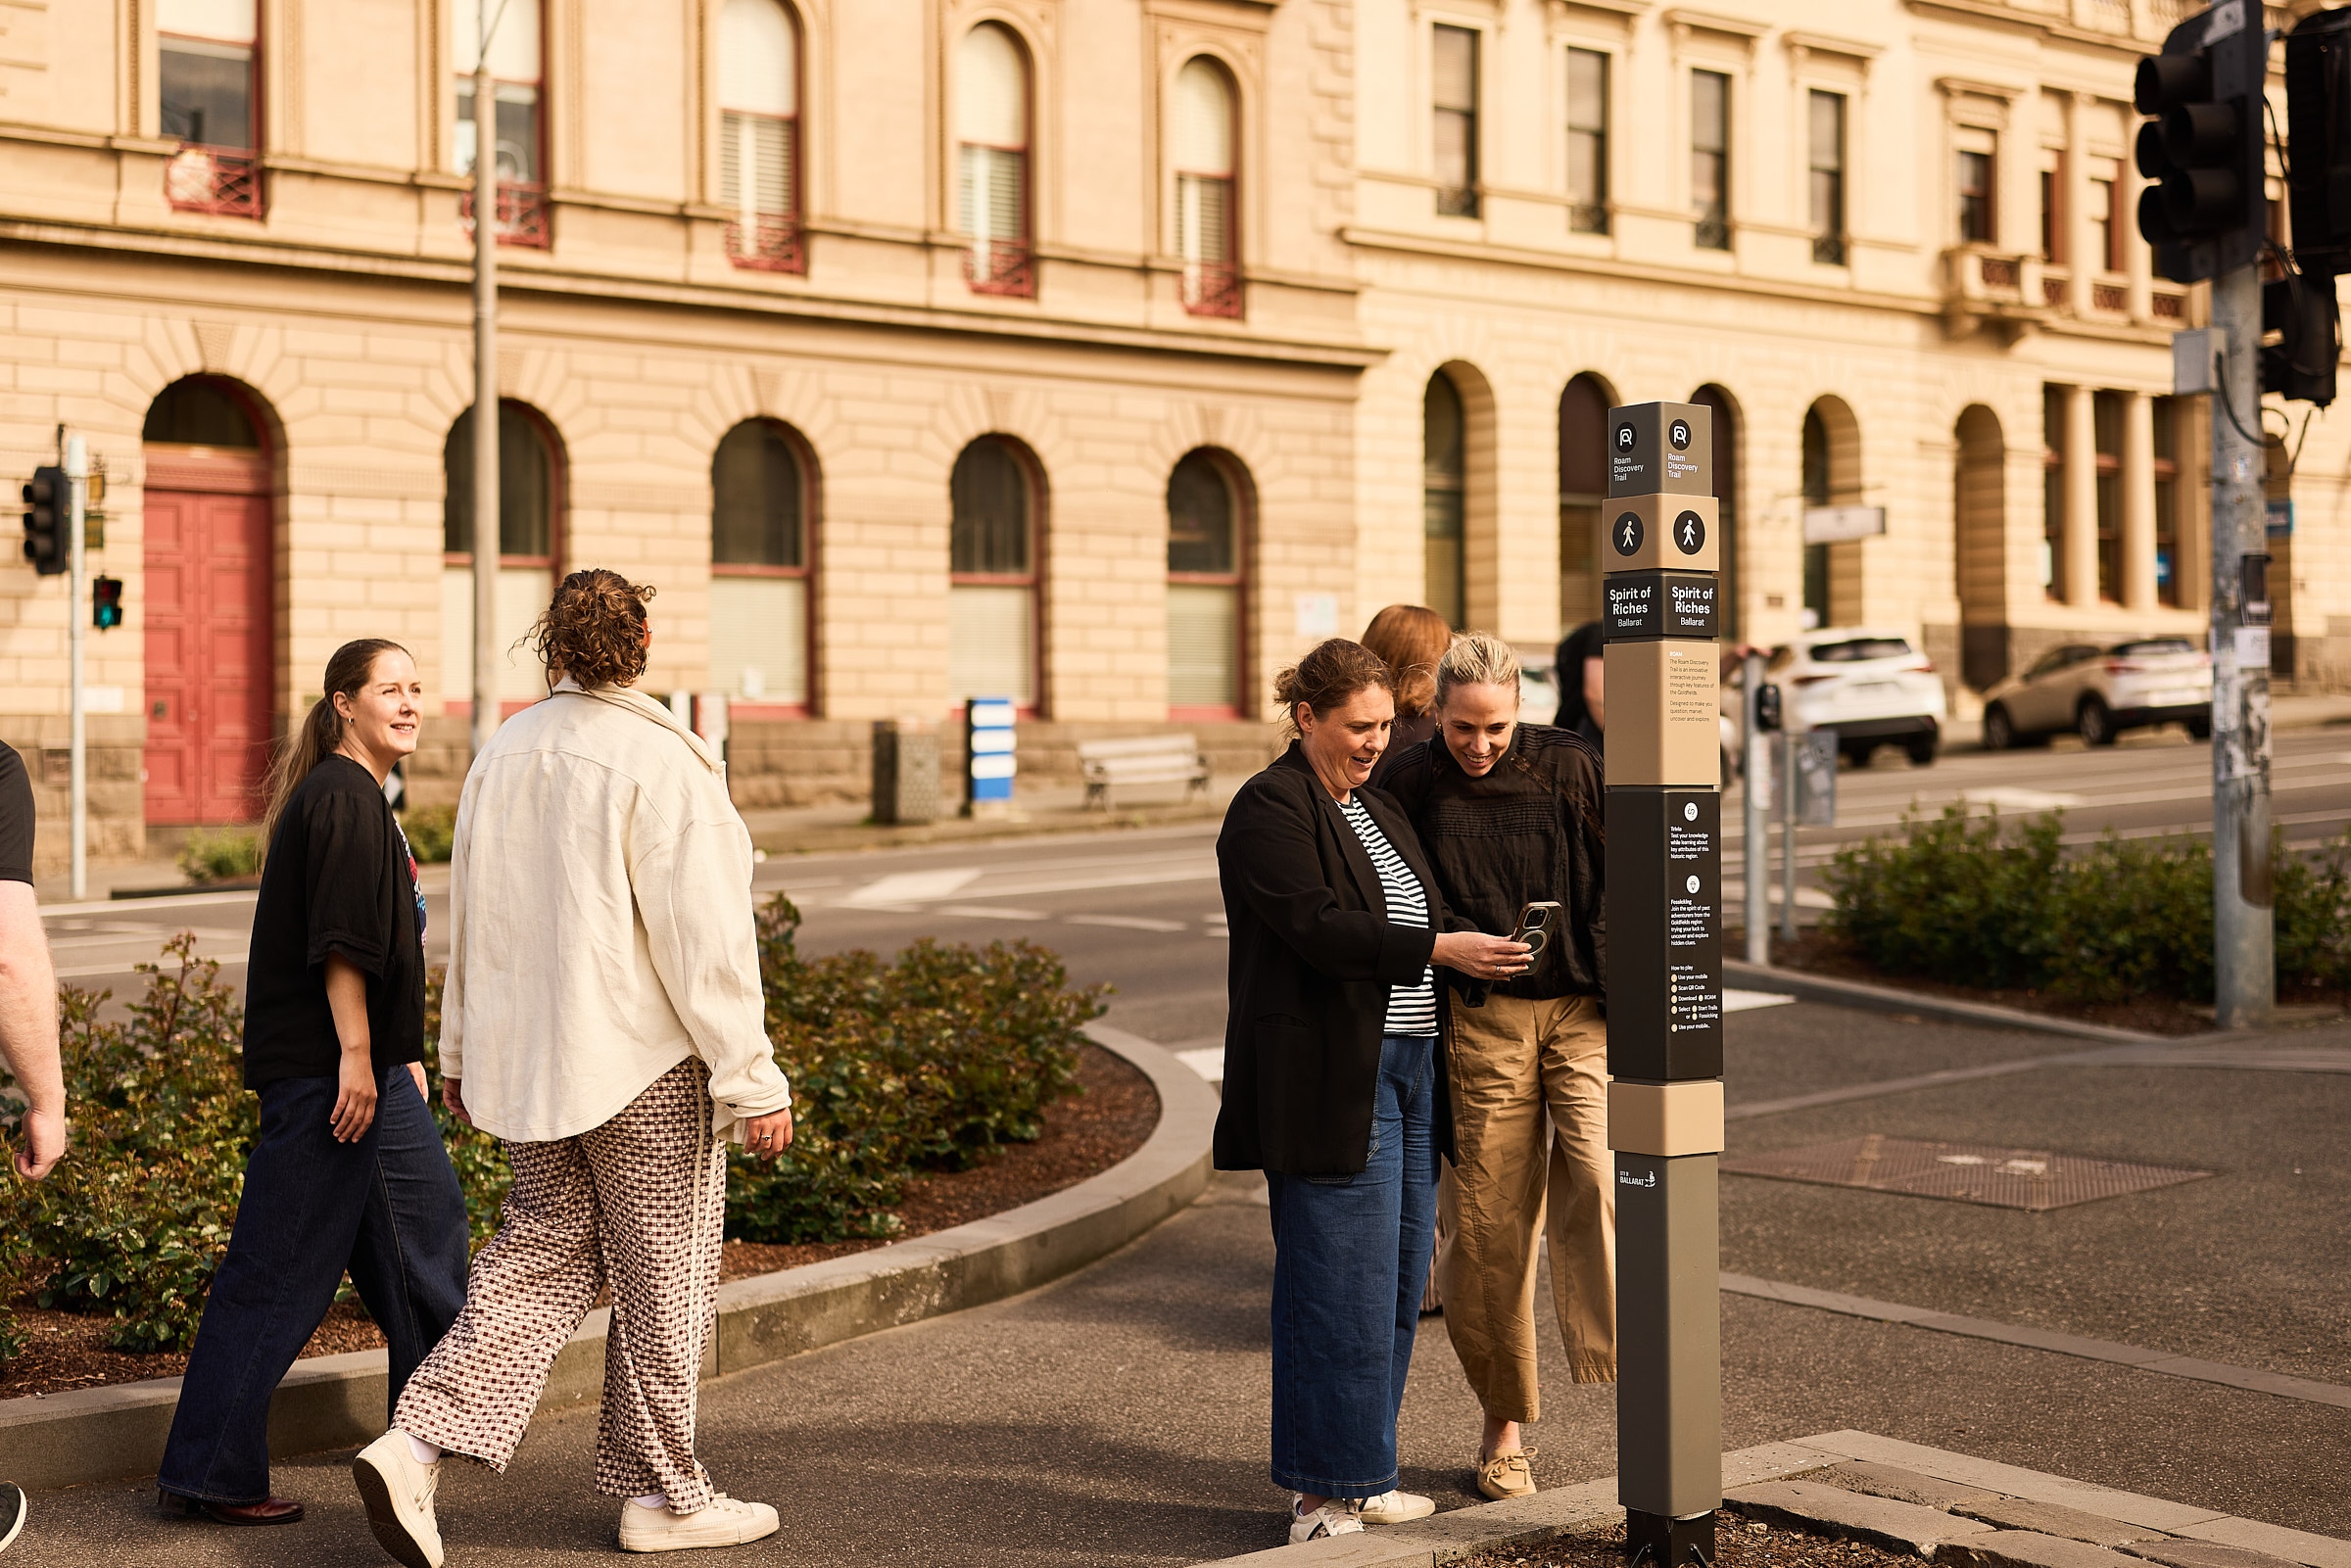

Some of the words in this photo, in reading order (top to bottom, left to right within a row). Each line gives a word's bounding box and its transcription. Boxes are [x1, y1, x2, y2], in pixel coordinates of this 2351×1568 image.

[1614, 464, 1644, 473] Discovery
[1668, 462, 1699, 473] Discovery
[1614, 473, 1627, 482] Trail
[1609, 588, 1638, 603] Spirit
[1641, 587, 1652, 598] of
[1672, 586, 1701, 601] Spirit
[1703, 588, 1713, 599] of
[1612, 602, 1649, 615] Riches
[1675, 601, 1710, 614] Riches
[1617, 618, 1643, 627] Ballarat
[1680, 617, 1704, 627] Ballarat
[1620, 1176, 1644, 1185] BALLARAT
